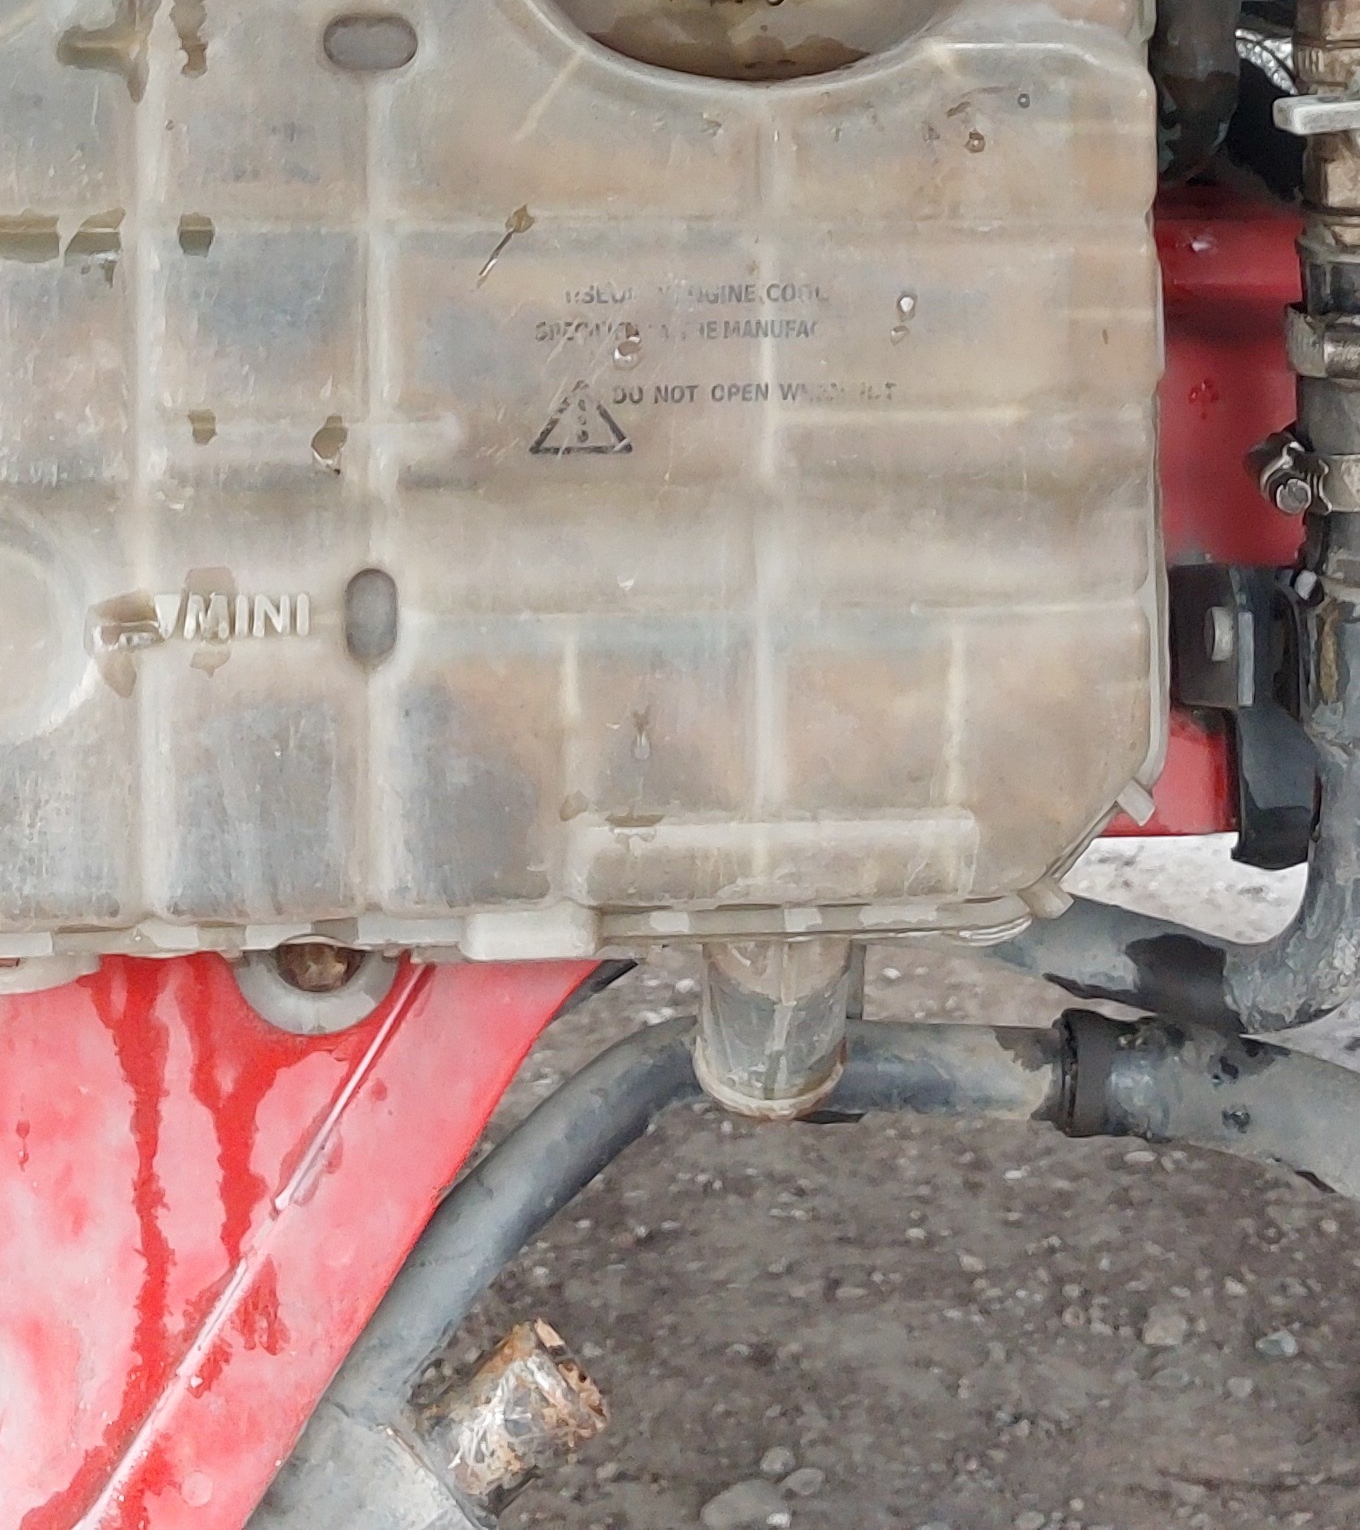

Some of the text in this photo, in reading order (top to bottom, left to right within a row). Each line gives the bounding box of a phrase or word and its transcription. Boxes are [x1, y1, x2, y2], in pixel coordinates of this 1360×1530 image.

[613, 384, 644, 405] DO
[654, 384, 699, 404] NOT
[711, 381, 769, 402] OPEN
[182, 592, 312, 640] MINI
